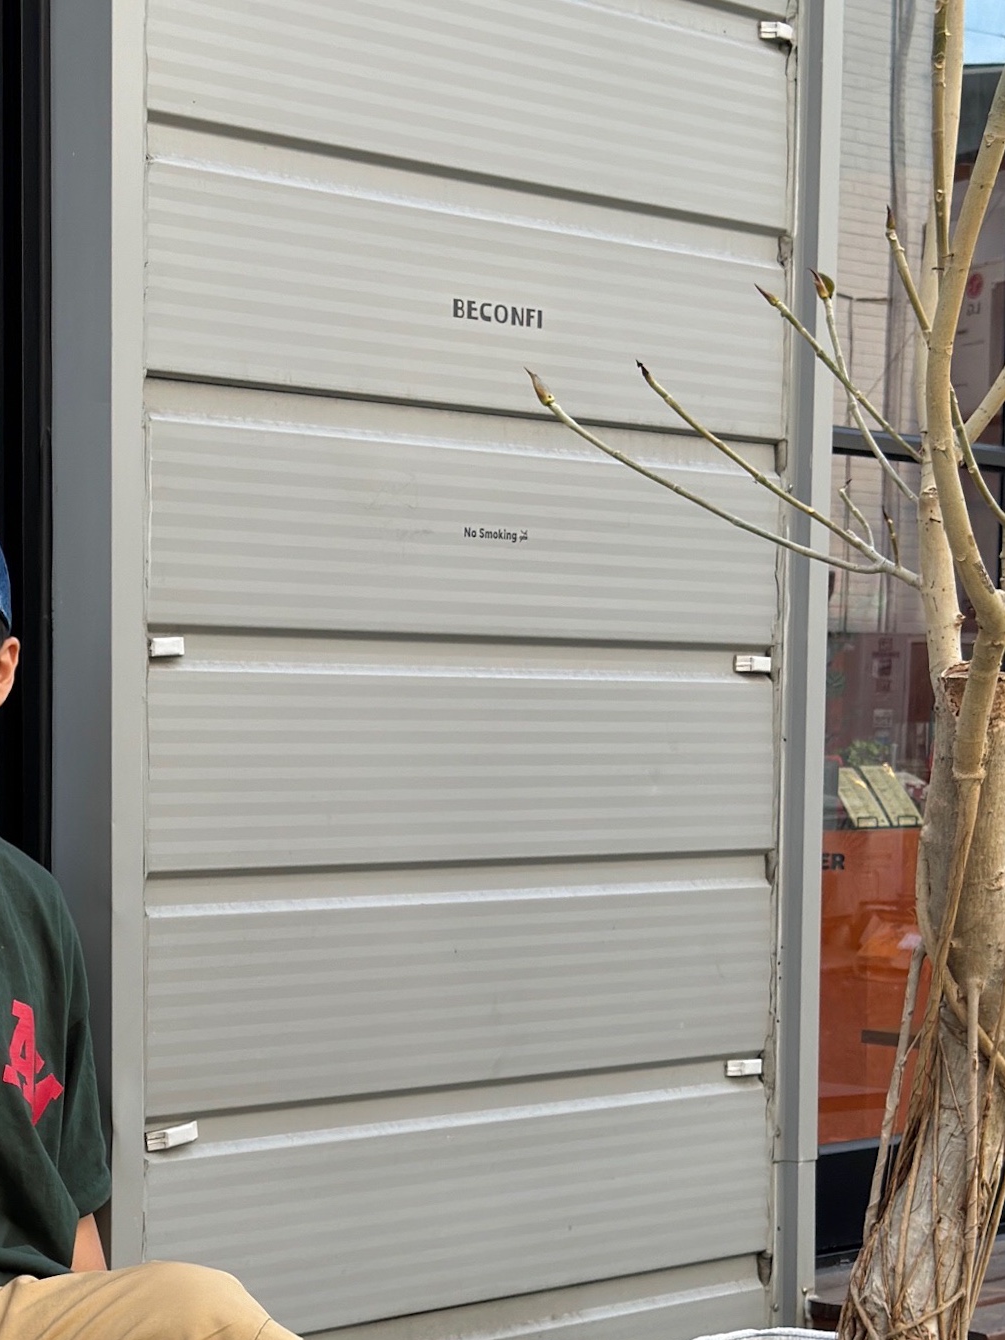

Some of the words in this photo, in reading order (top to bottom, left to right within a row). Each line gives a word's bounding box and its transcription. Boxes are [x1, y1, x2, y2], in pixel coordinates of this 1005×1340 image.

[452, 298, 543, 329] BECONFI
[463, 527, 477, 538] No
[479, 528, 518, 543] Smoking
